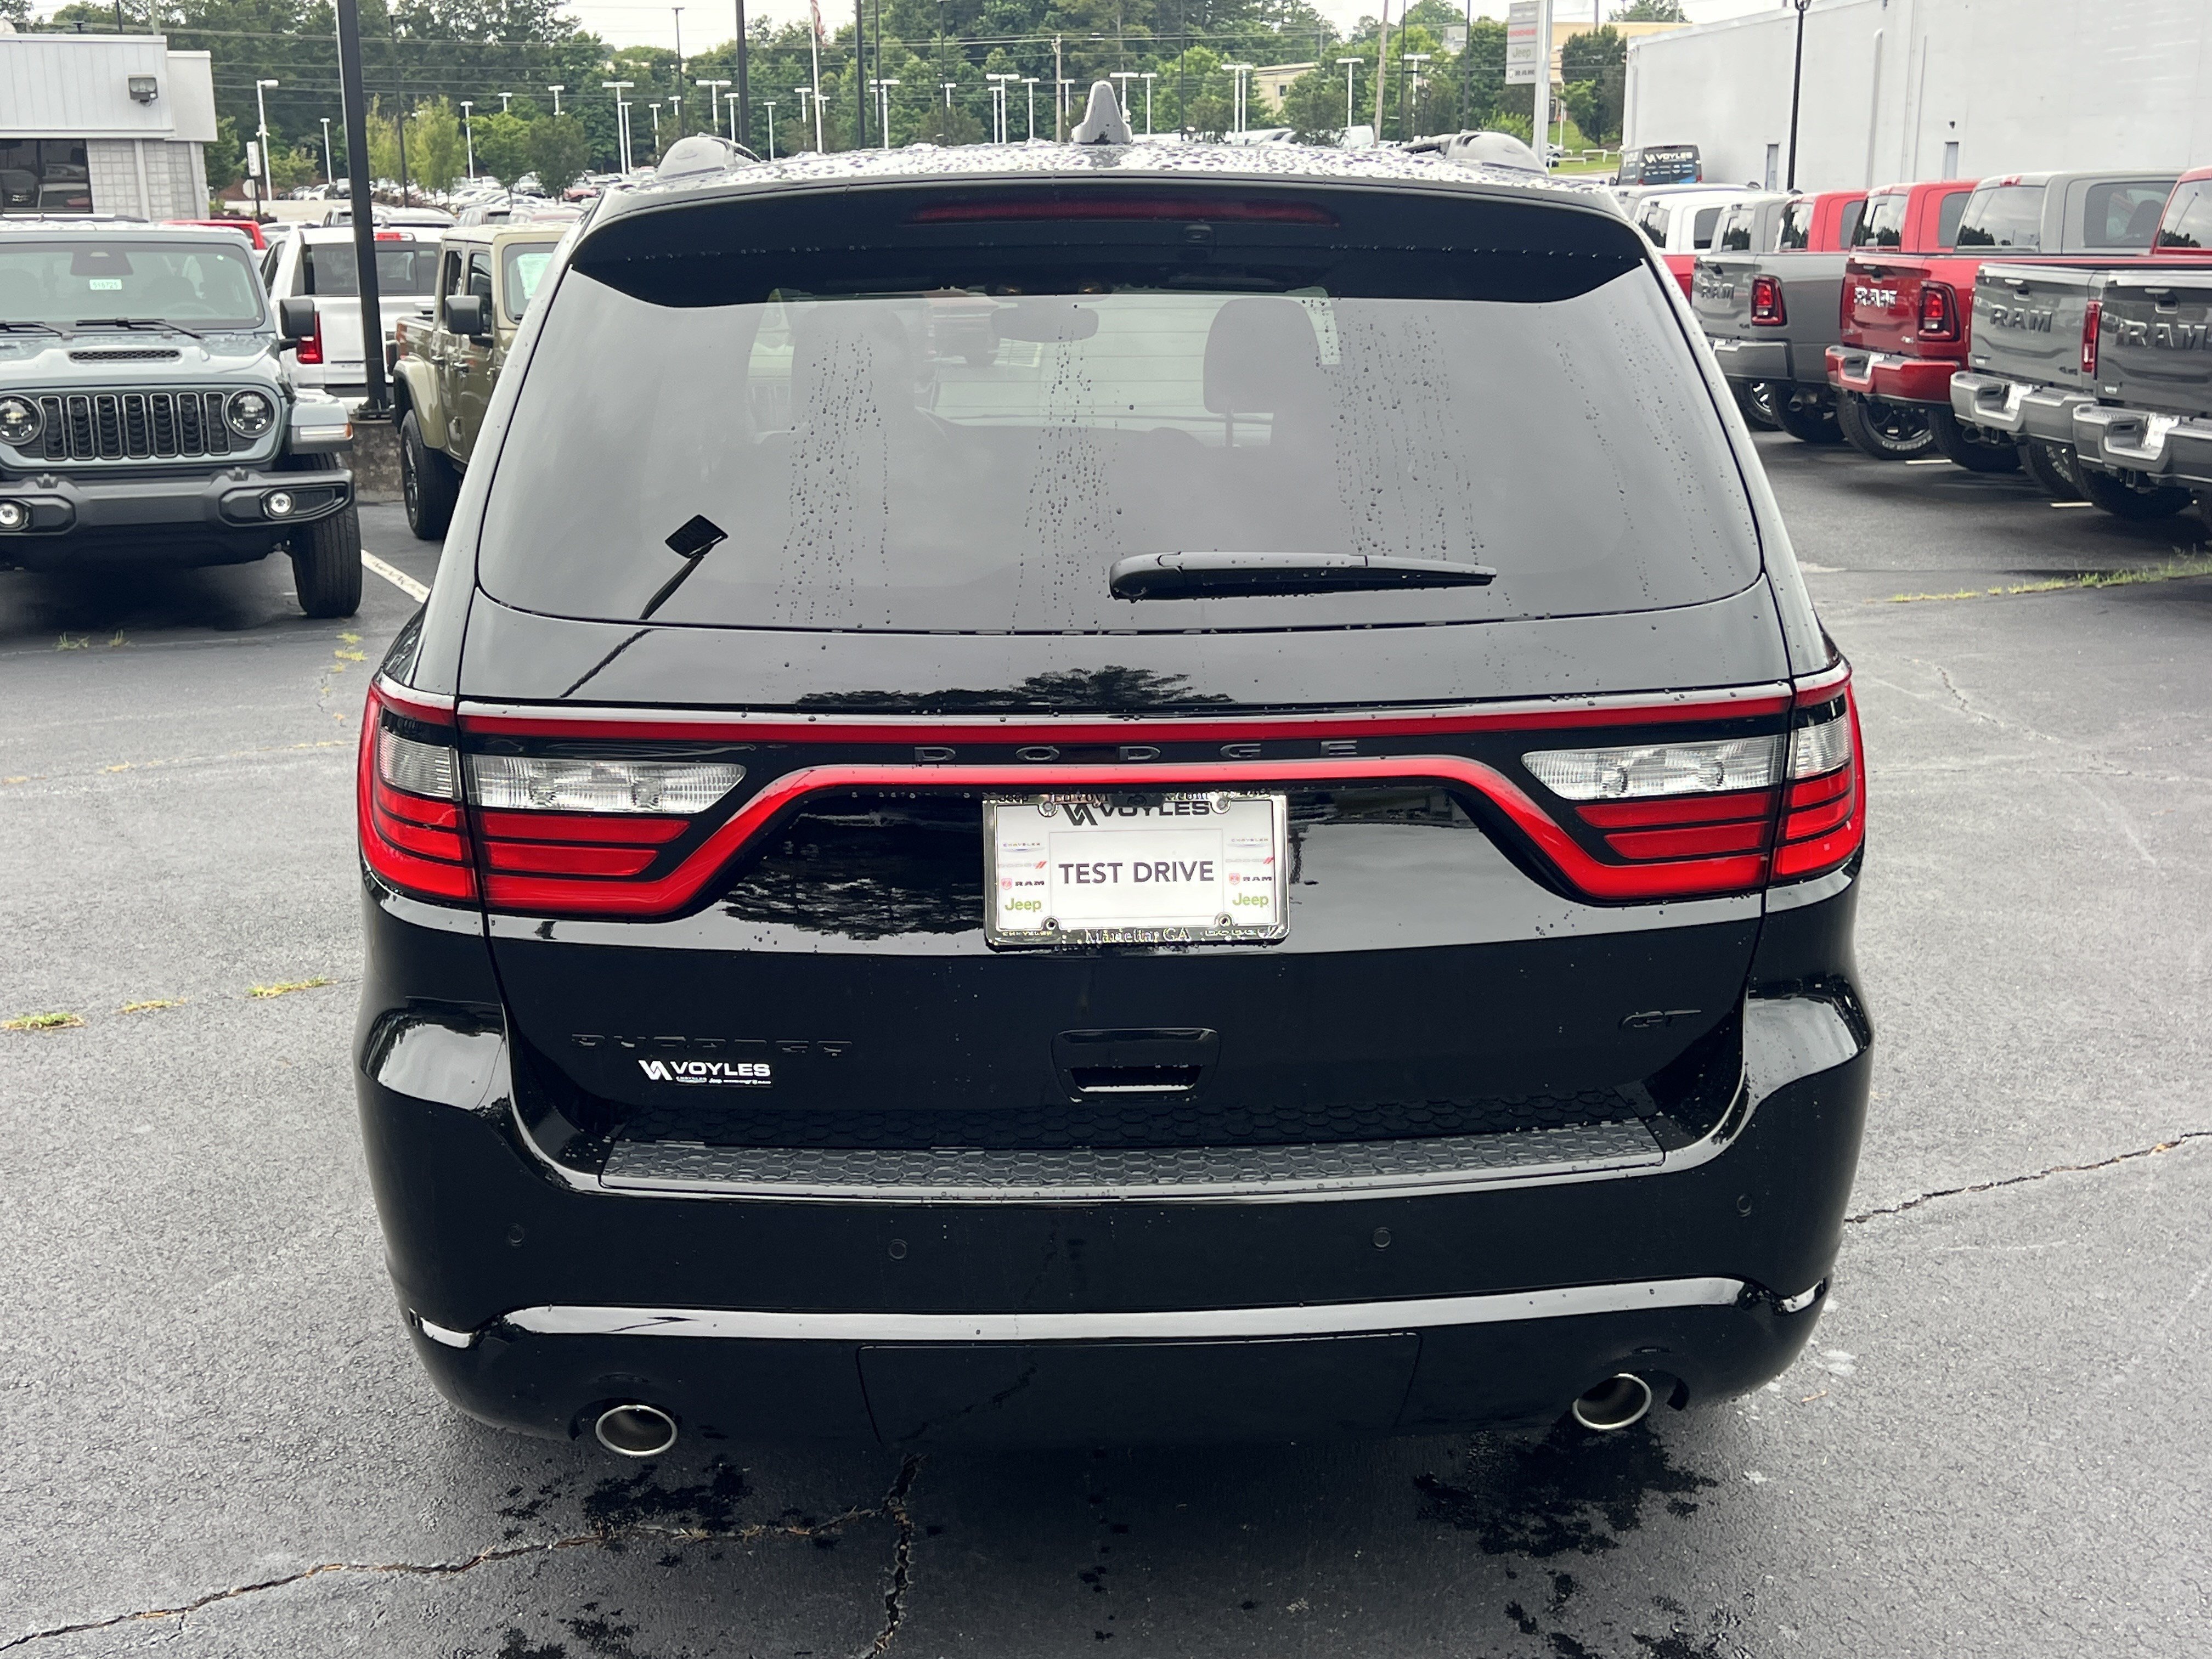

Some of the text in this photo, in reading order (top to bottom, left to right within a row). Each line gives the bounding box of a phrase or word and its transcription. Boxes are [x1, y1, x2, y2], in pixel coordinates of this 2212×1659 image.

[1513, 47, 1531, 59] Jeep
[1990, 304, 2052, 332] RAM
[2116, 319, 2209, 350] RAM
[913, 738, 1357, 764] DODGE
[1058, 860, 1214, 884] TEST DRIVE
[1005, 898, 1041, 912] Jeep
[1232, 893, 1269, 908] Jeep
[1163, 927, 1192, 942] GA
[670, 1061, 771, 1077] VOYLES
